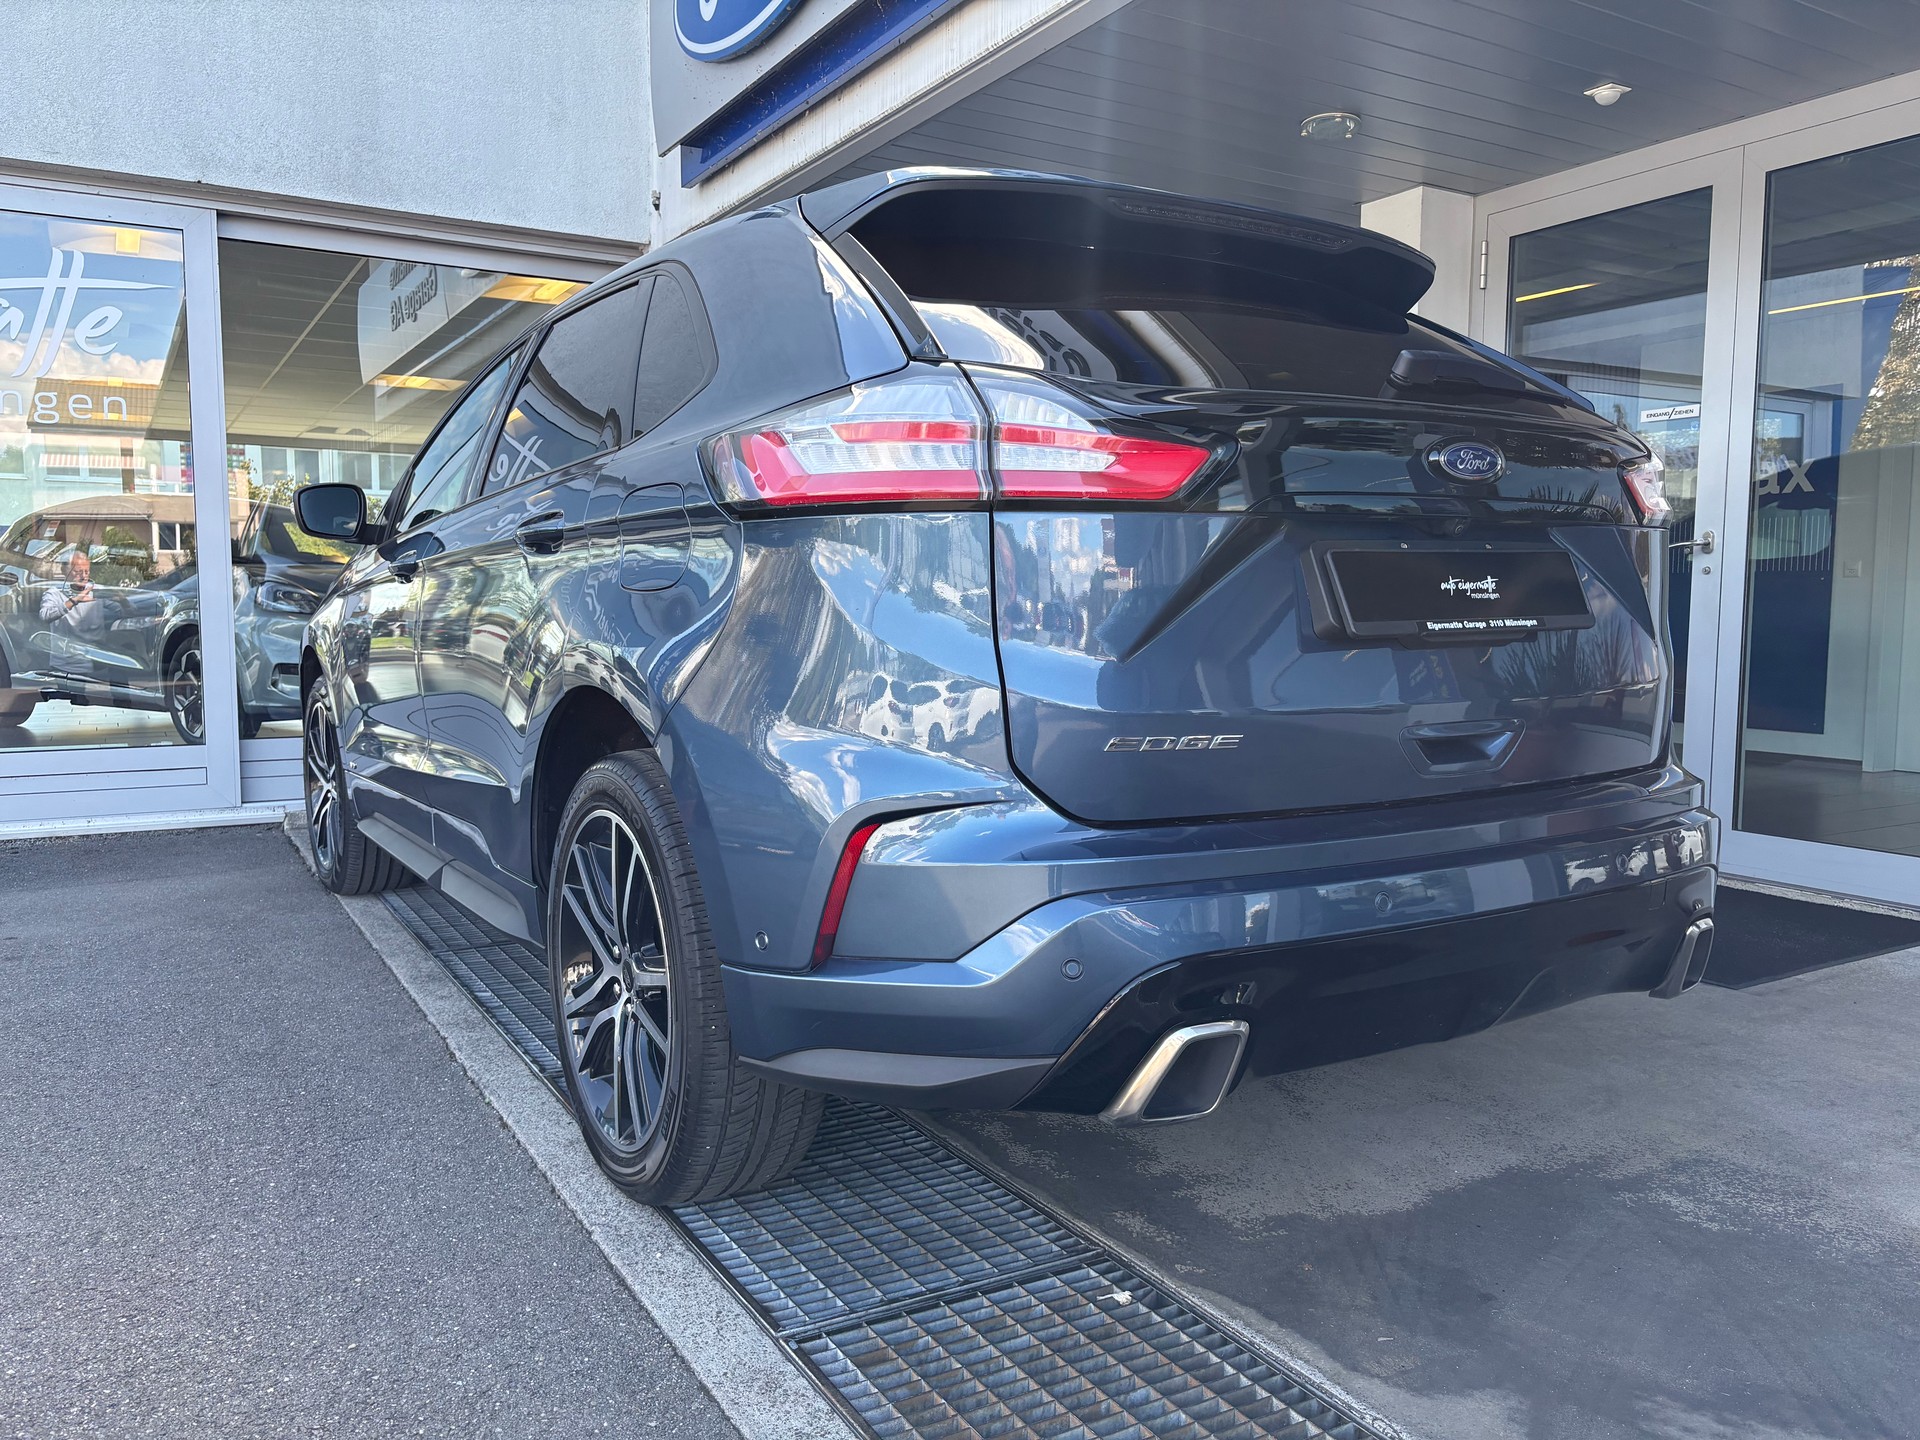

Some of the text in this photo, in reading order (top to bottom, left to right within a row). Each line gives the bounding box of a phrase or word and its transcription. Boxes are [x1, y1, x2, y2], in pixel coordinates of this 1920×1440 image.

[1456, 449, 1490, 470] Ford
[1440, 575, 1499, 596] auto eigermatte
[1426, 618, 1538, 630] Eigermatte Garage 3110 Münsingen
[1104, 734, 1244, 752] EDGE
[606, 783, 641, 830] ZERO
